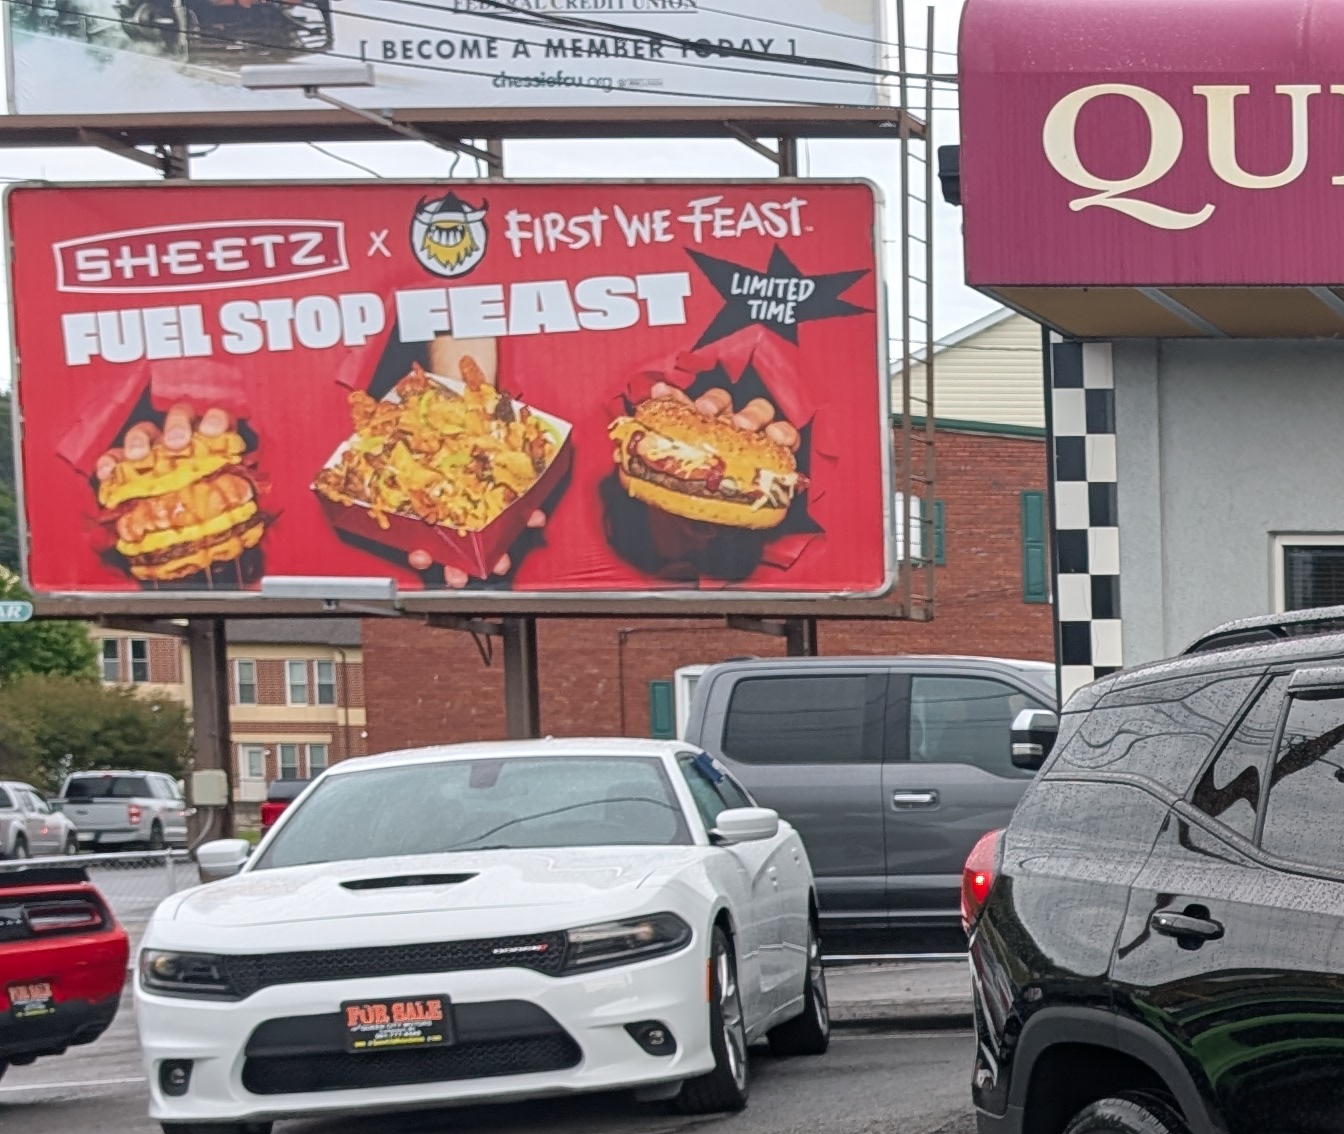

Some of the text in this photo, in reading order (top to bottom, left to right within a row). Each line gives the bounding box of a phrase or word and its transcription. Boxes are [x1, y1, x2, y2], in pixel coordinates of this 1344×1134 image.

[381, 39, 499, 60] BECOME
[511, 38, 533, 59] A
[544, 38, 665, 60] MEMBER
[504, 195, 809, 258] FIRST WE FEAST
[75, 231, 327, 283] SHEETZ
[730, 271, 815, 302] LIMITED
[61, 272, 692, 367] FUEL STOP FEAST
[747, 299, 797, 324] TIME
[346, 1003, 390, 1027] FOR
[391, 999, 443, 1023] SALE
